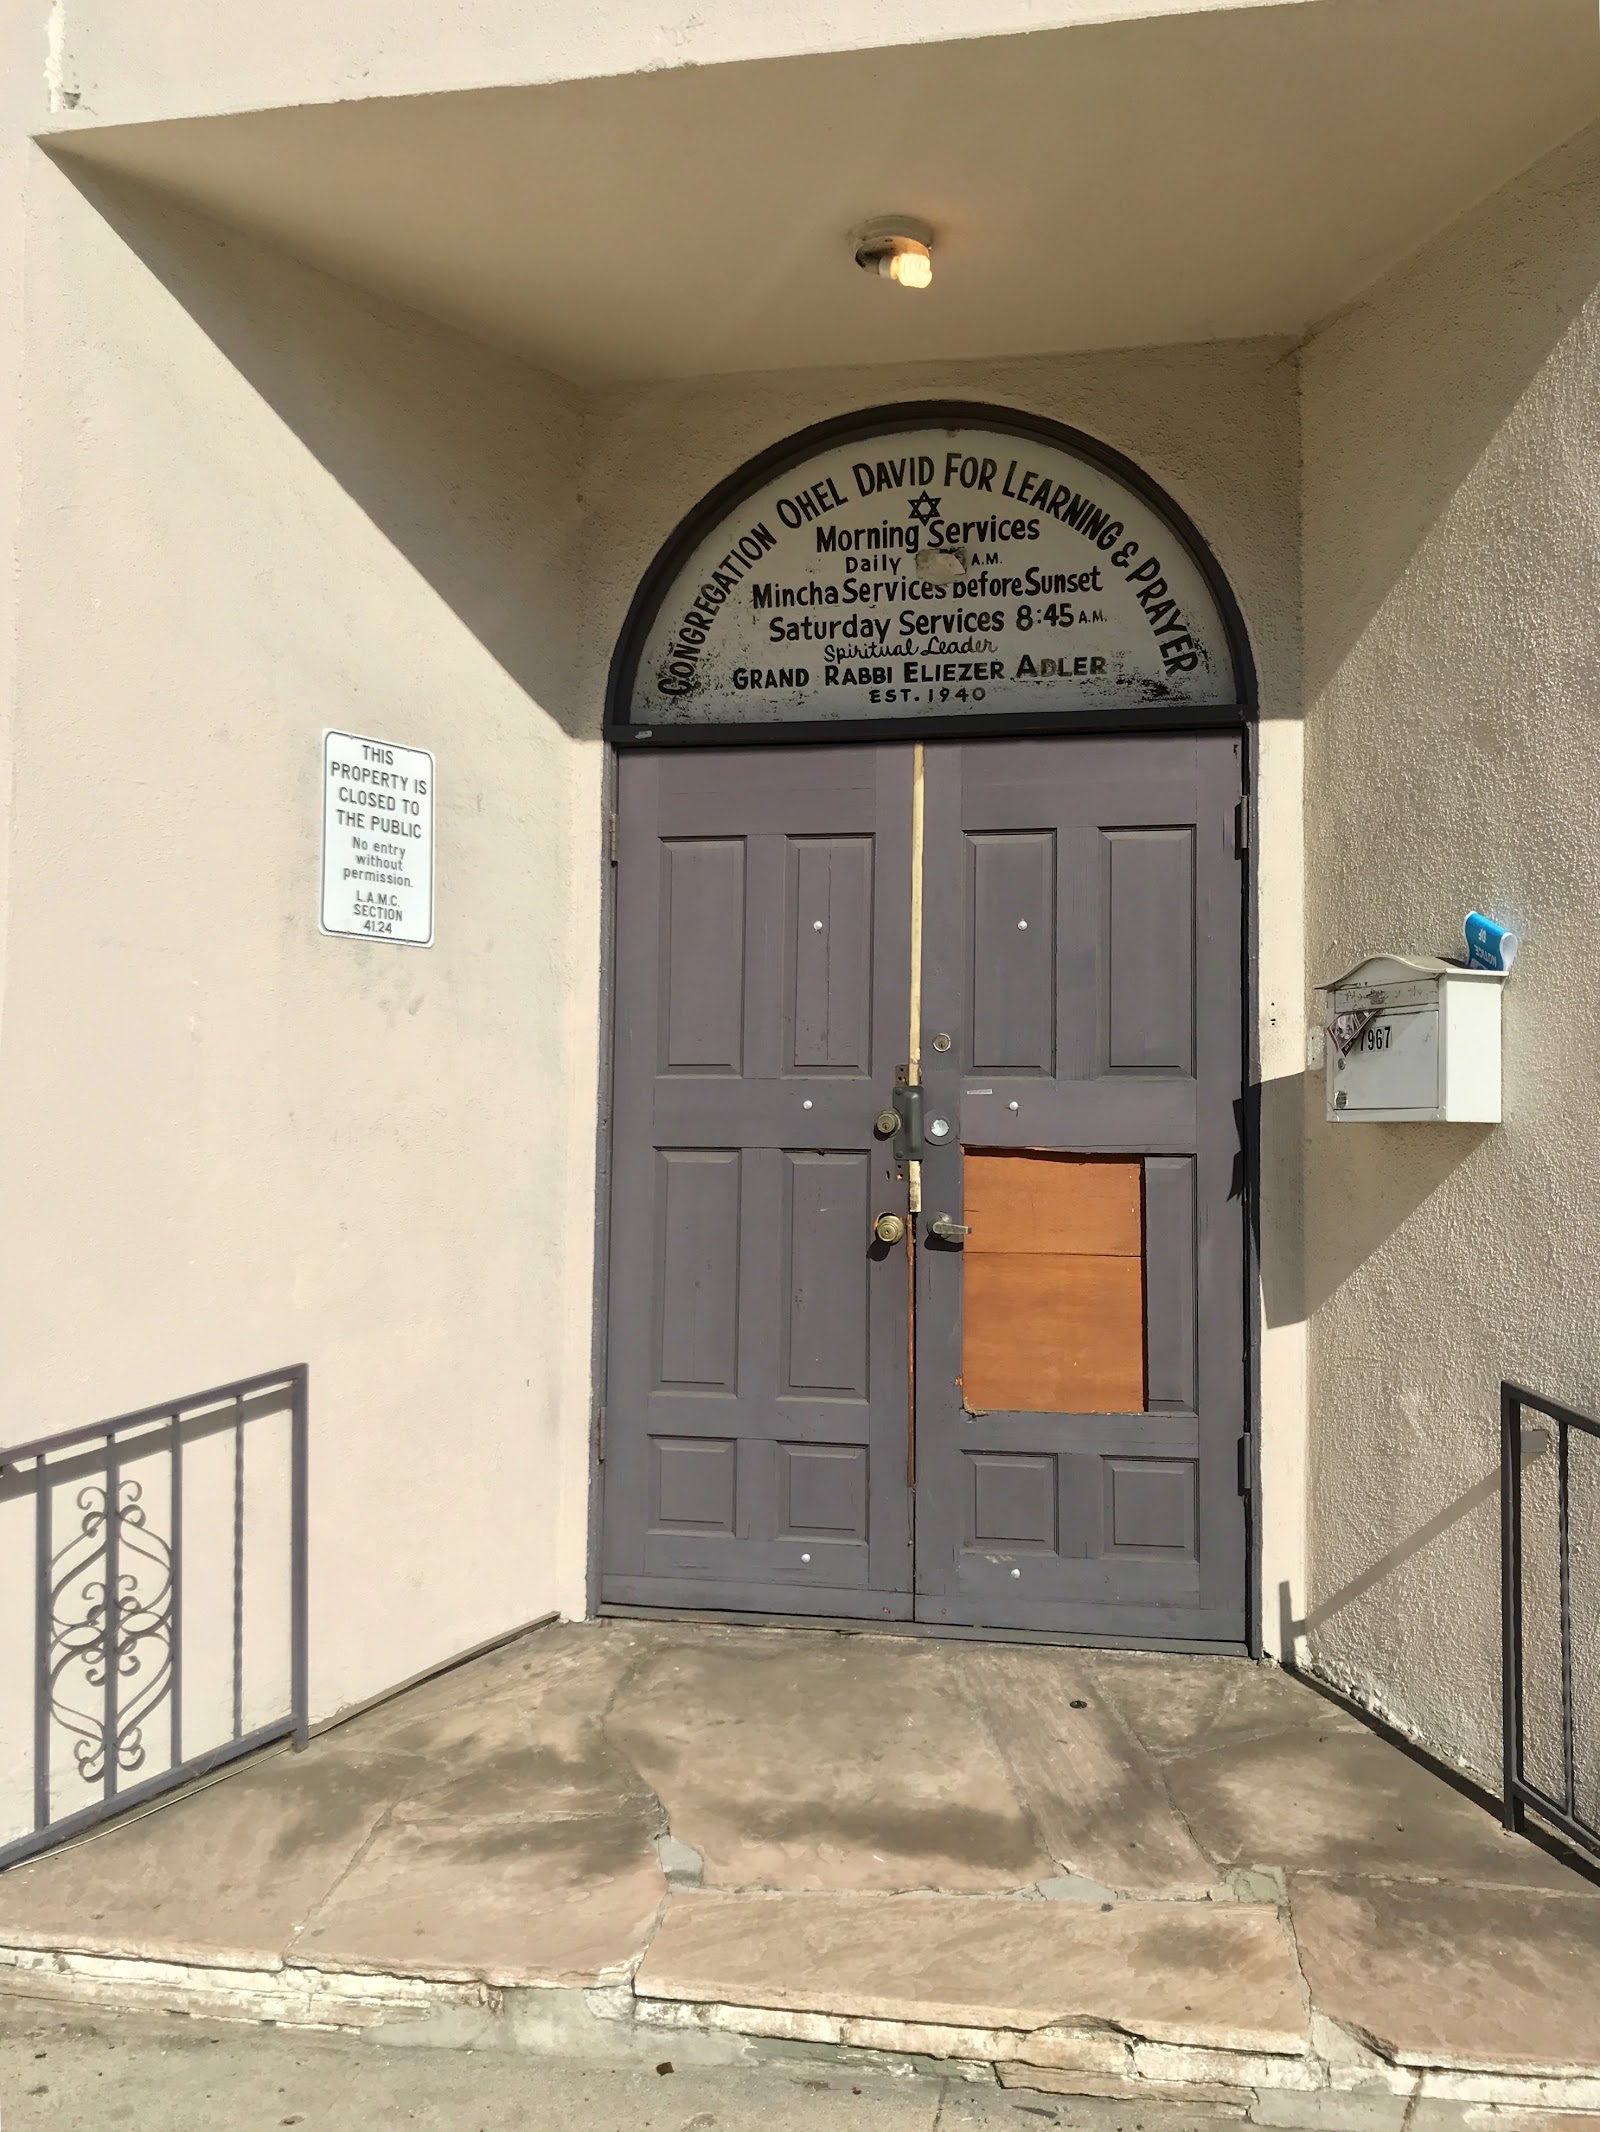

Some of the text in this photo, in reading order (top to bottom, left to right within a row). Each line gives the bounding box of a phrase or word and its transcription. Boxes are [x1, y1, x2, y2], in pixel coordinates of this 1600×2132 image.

[816, 515, 1040, 553] Morning Services
[657, 452, 1198, 696] CONGREGATION OHEL DAVID FOR LEARNING & PRAYER
[845, 552, 1003, 575] Daily A.M.
[752, 581, 838, 609] Mincha
[841, 577, 947, 604] Services
[1024, 566, 1103, 594] Sunset
[769, 604, 1108, 644] Saturday Services 8:45 A.M.
[823, 635, 998, 664] Spiritual Leader
[732, 654, 1108, 690] GRAND RABBI ELIEZER ADLER
[869, 686, 987, 704] EST. 1940
[361, 744, 394, 766] THIS
[330, 761, 428, 795] PROPERTY IS
[339, 787, 420, 817] CLOSED TO
[336, 809, 422, 840] THE PUBLIC
[352, 836, 406, 861] No entry
[343, 867, 415, 889] permission.
[355, 854, 404, 873] without
[352, 904, 404, 923] SECTION
[355, 890, 401, 909] L.A.M.C.
